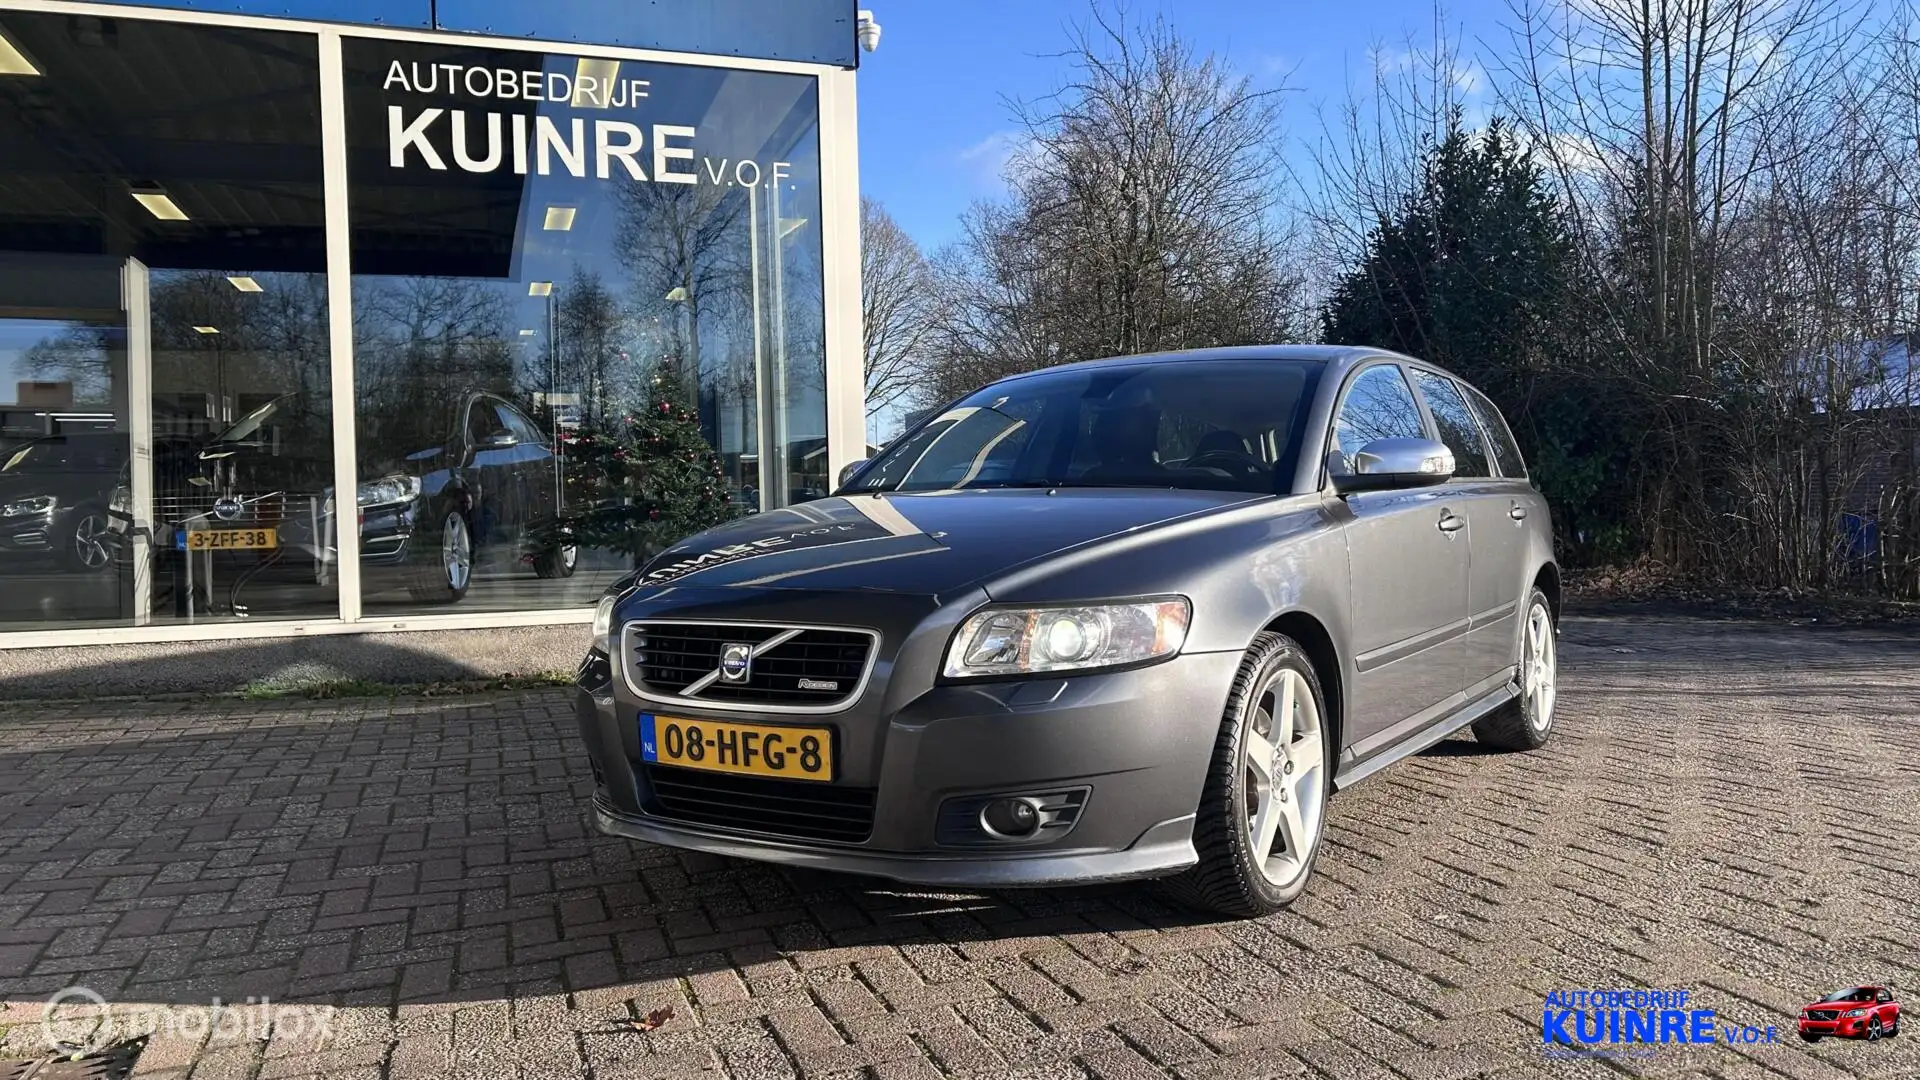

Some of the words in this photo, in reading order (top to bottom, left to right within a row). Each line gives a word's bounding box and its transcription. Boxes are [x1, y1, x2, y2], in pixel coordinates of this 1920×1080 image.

[383, 60, 650, 109] AUTOBEDRIJF
[387, 105, 698, 185] KUINRE
[704, 157, 797, 191] V.O.F.
[193, 531, 267, 547] 3-ZFF-38
[644, 742, 656, 754] NL
[664, 723, 822, 773] 08-HFG-8
